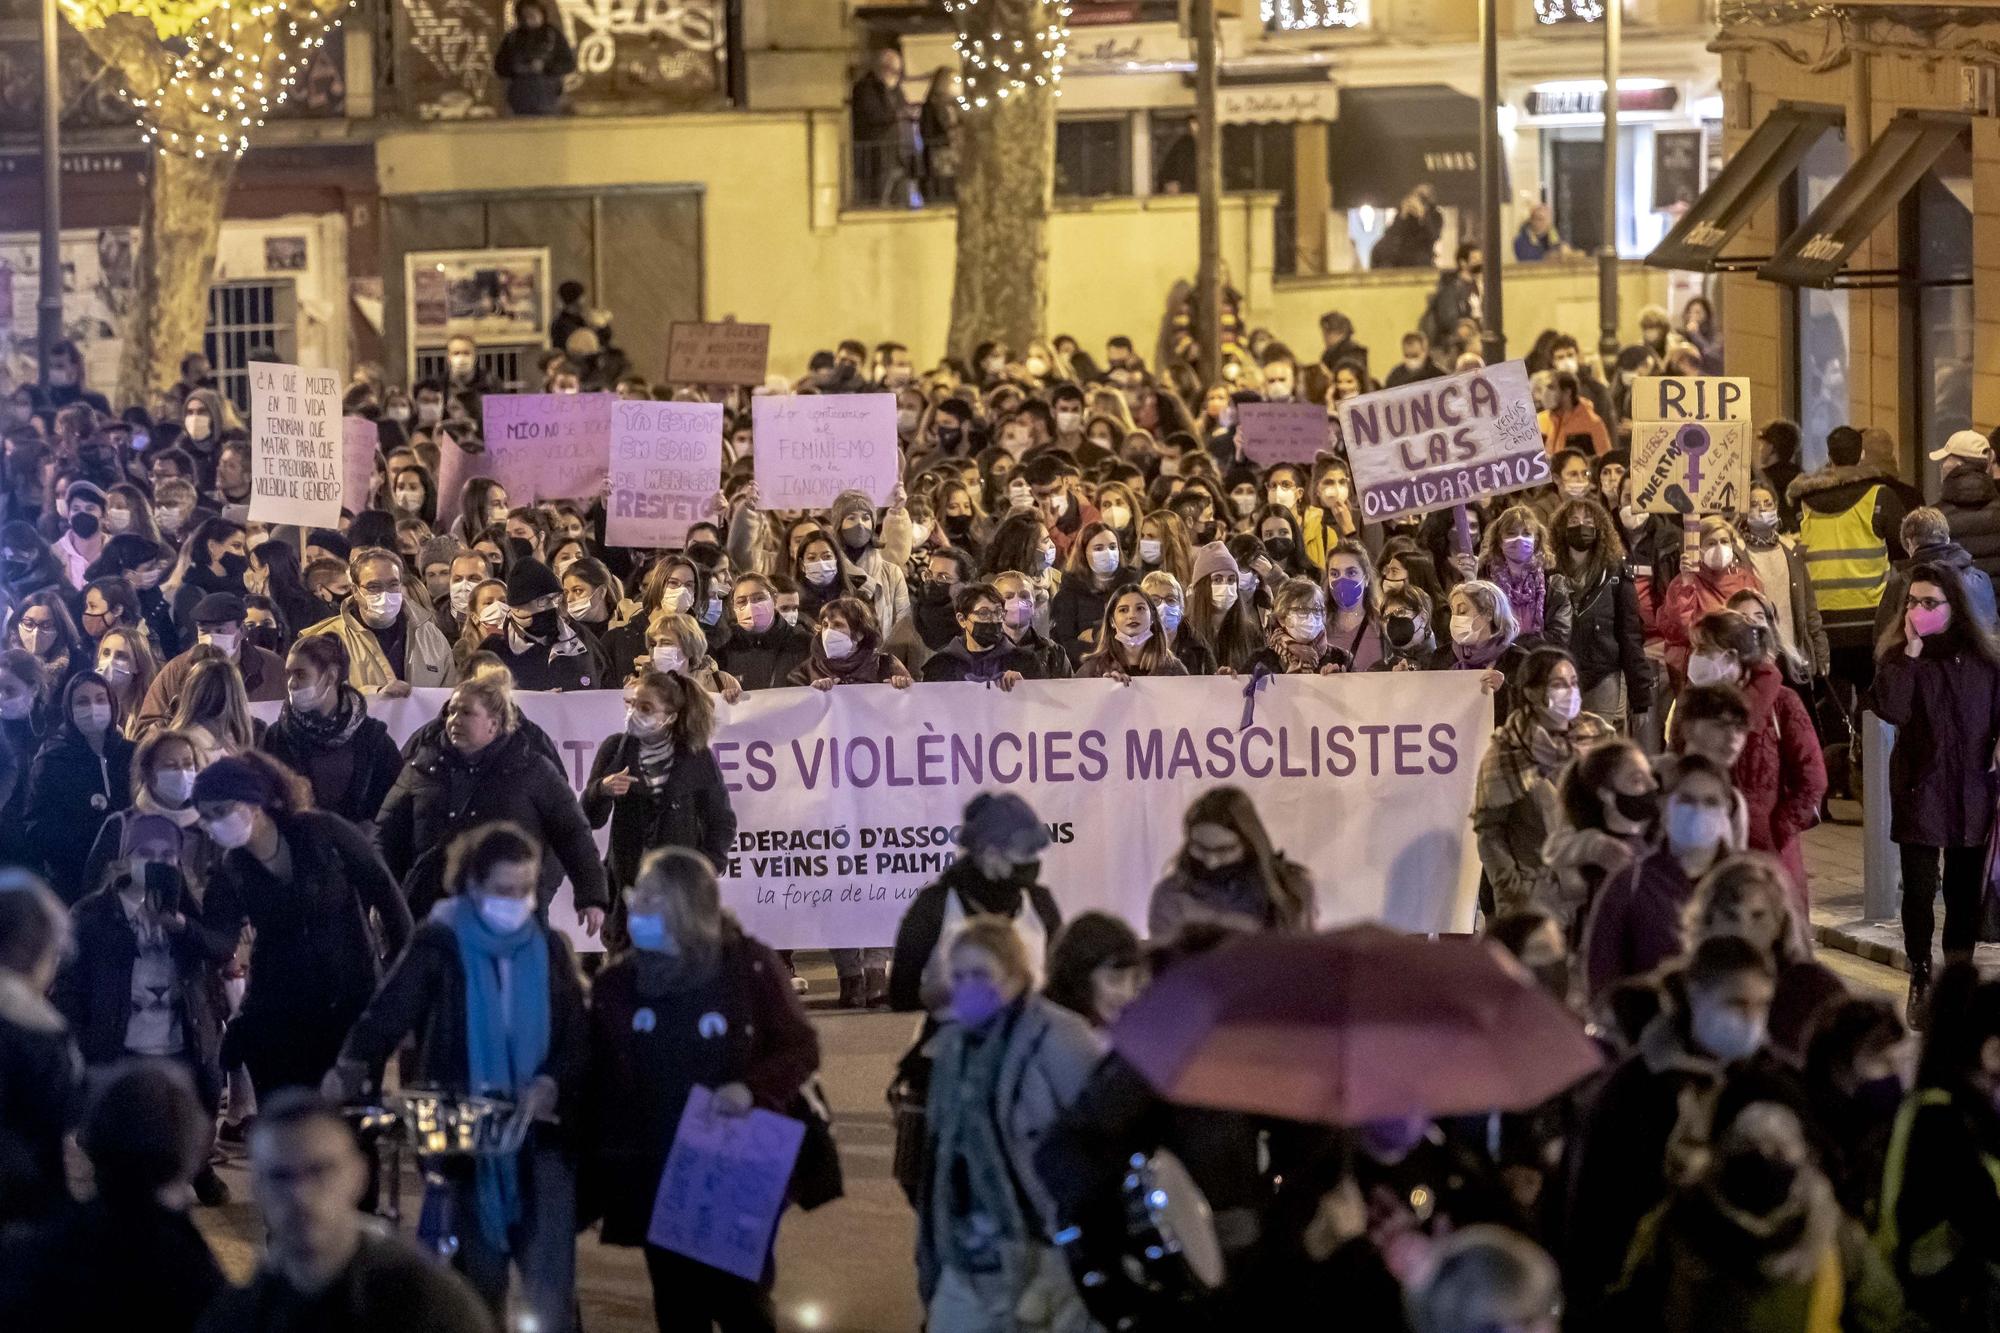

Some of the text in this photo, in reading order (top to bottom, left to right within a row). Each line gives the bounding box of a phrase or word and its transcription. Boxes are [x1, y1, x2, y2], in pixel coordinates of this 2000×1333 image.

[305, 377, 336, 396] MUJER
[267, 395, 326, 417] EN TU VIDA
[1350, 377, 1498, 446] NUNCA
[309, 420, 326, 438] QUE
[545, 423, 559, 438] NO
[657, 408, 719, 433] ESTOY
[261, 436, 335, 459] MATAR PARA QUE
[620, 435, 708, 462] EN EDAD
[1401, 427, 1478, 471] LAS
[1707, 429, 1739, 467] LEYES
[263, 457, 274, 475] TE
[322, 463, 335, 481] LA
[255, 476, 287, 497] VIOLENCIA
[289, 480, 299, 499] DE
[615, 488, 716, 521] RESPETO
[712, 722, 1458, 792] ES VIOLÈNCIES MASCLISTES
[727, 825, 851, 852] DERACIÓ
[750, 852, 829, 878] VEÏNS
[836, 854, 868, 876] DE
[757, 886, 775, 905] la
[782, 883, 833, 911] força
[840, 883, 862, 903] de
[869, 883, 886, 901] la
